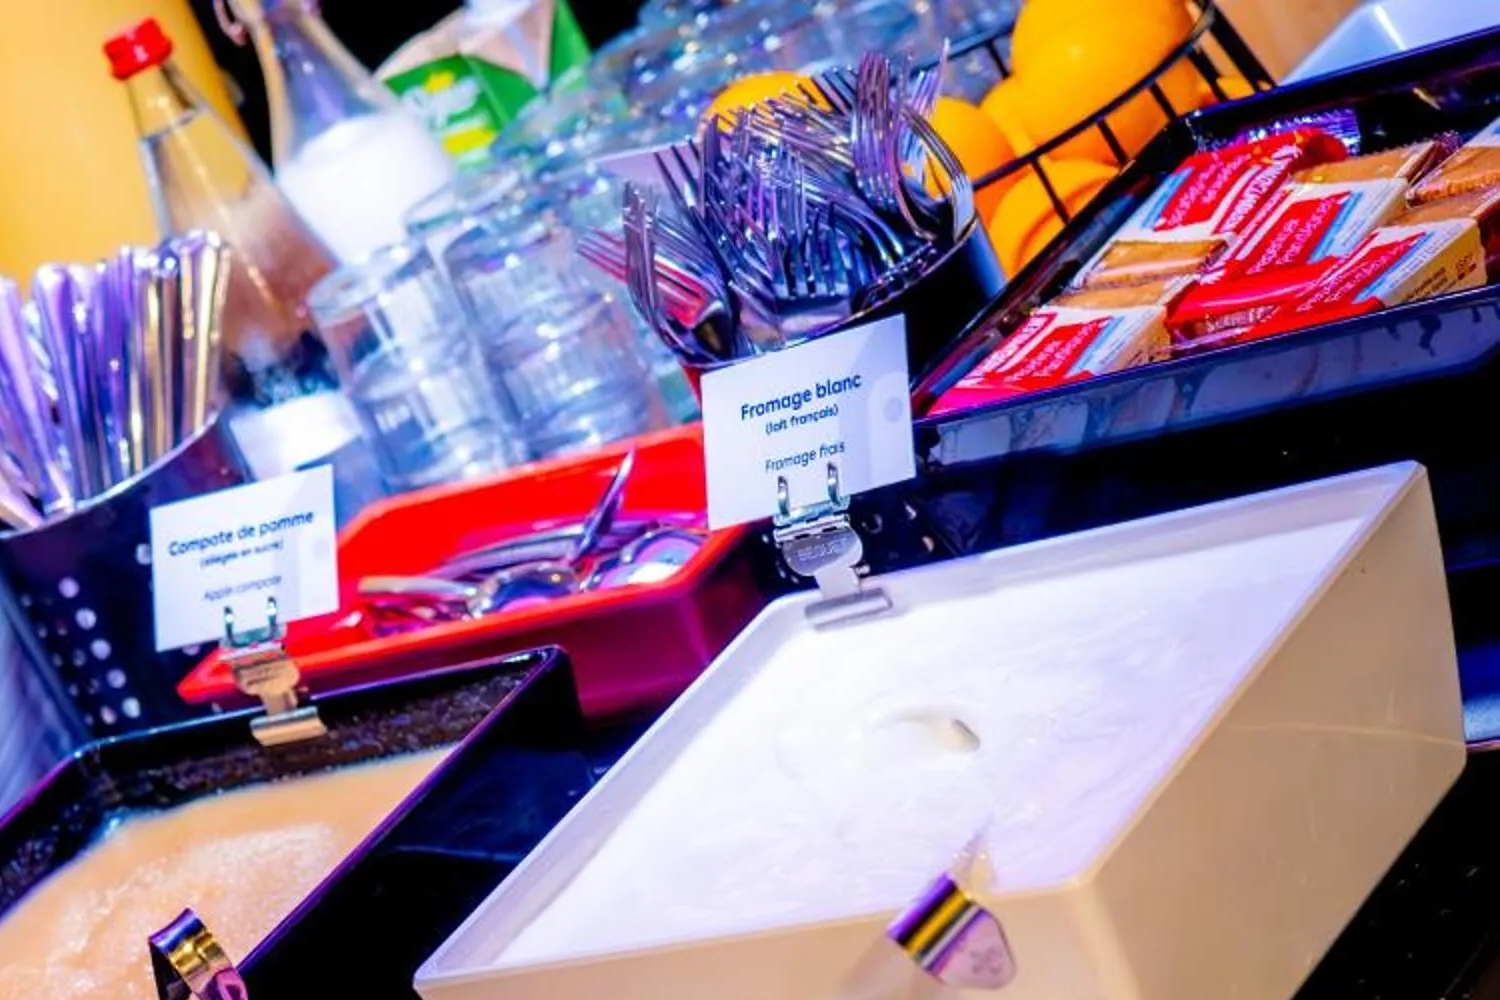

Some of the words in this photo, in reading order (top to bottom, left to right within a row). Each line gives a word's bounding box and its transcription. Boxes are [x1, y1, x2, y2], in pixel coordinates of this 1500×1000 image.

[741, 388, 813, 420] Fromage
[816, 374, 862, 399] blanc
[765, 419, 788, 436] (lait
[790, 403, 839, 427] français)
[765, 449, 816, 472] Fromage
[819, 442, 845, 458] frais
[168, 531, 233, 556] Compote
[237, 525, 255, 541] de
[259, 512, 314, 537] pomme
